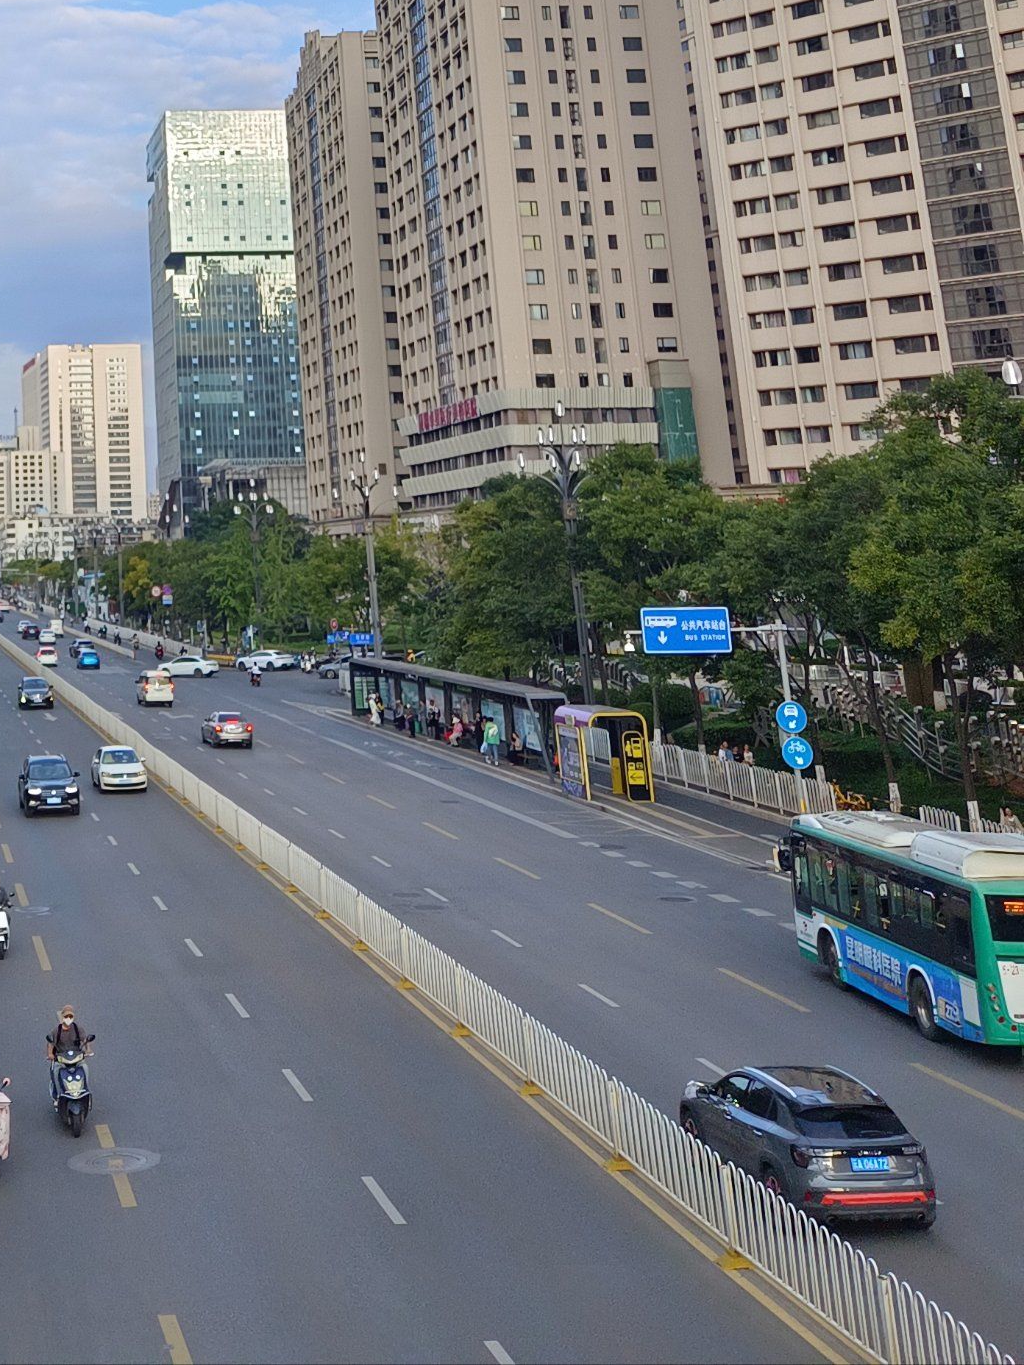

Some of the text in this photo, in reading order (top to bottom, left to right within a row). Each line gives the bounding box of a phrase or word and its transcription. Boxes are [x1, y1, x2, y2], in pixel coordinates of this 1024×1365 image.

[681, 619, 726, 631] 公共汽车站台
